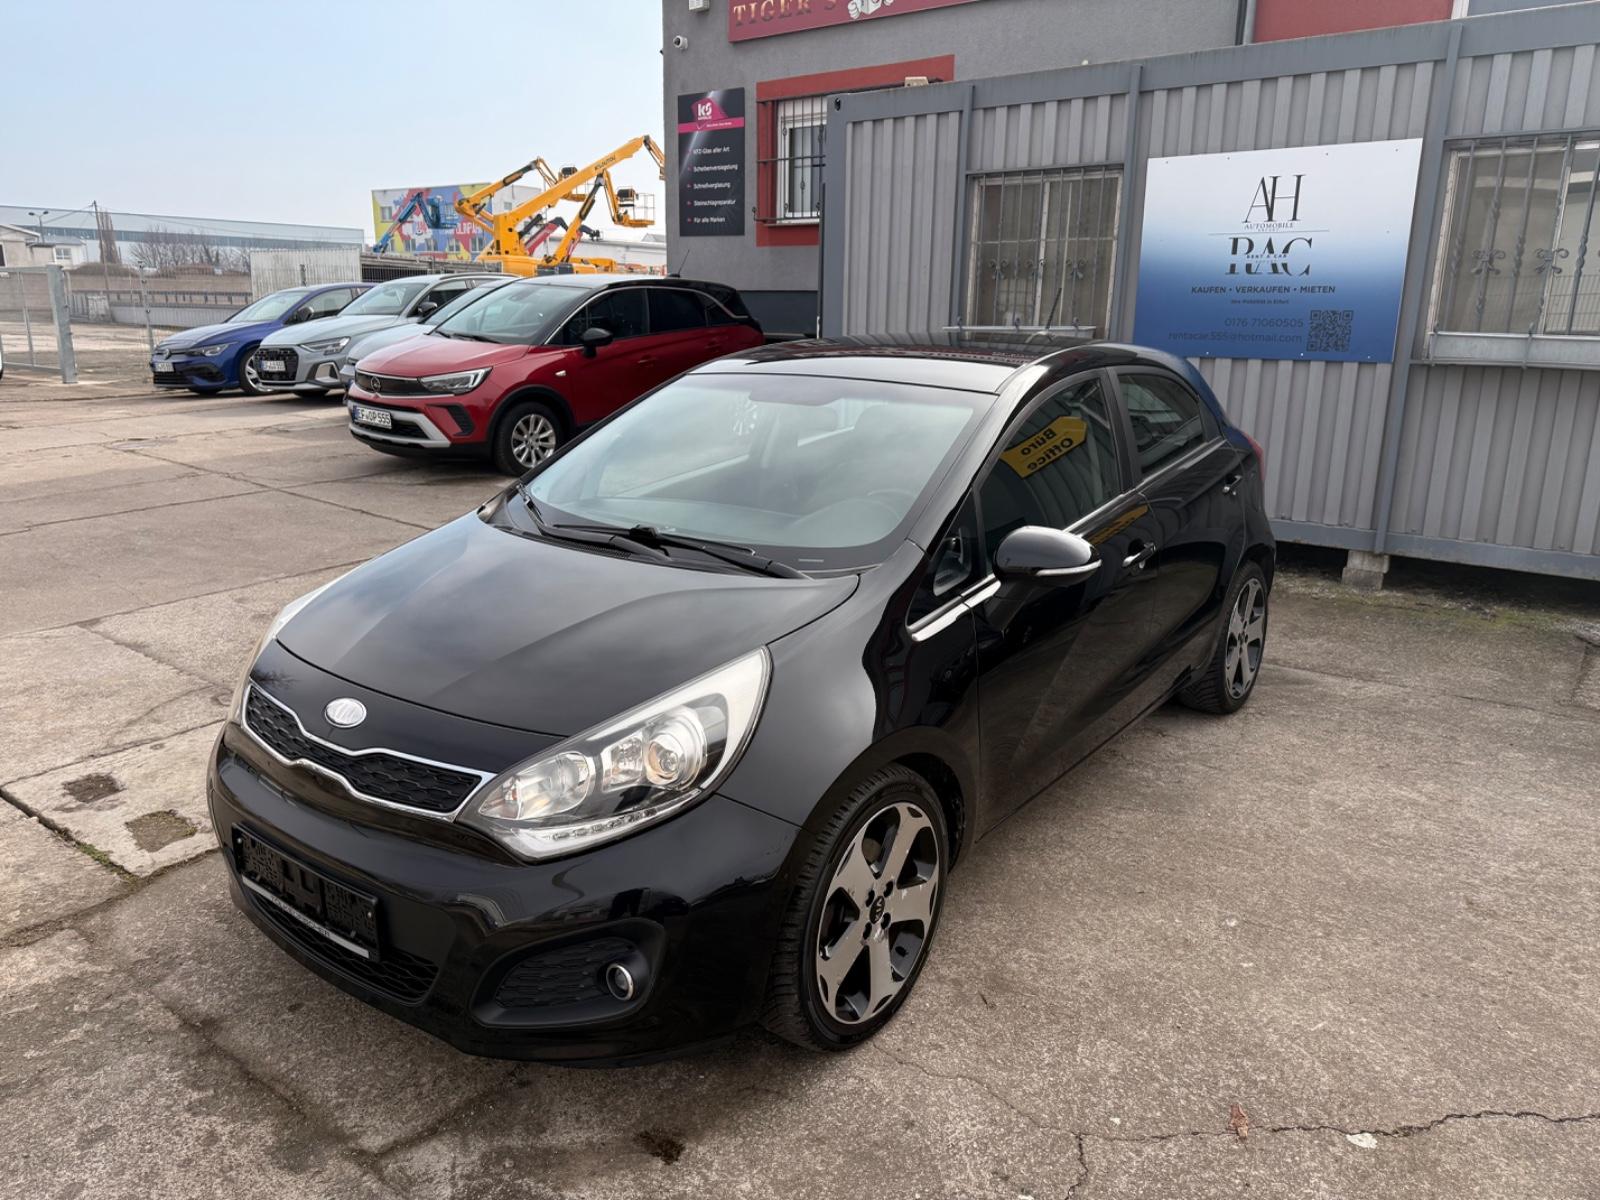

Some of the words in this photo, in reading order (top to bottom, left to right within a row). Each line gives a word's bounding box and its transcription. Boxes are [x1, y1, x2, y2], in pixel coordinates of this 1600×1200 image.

[1242, 174, 1306, 223] AH
[1244, 222, 1293, 230] AUTOMOBILE
[1225, 236, 1313, 276] RAC
[1191, 286, 1226, 294] KAUFEN
[1235, 285, 1291, 294] VERKAUFEN
[1300, 285, 1336, 293] MIETEN
[1224, 317, 1248, 327] 0176
[1251, 317, 1304, 328] 71060505
